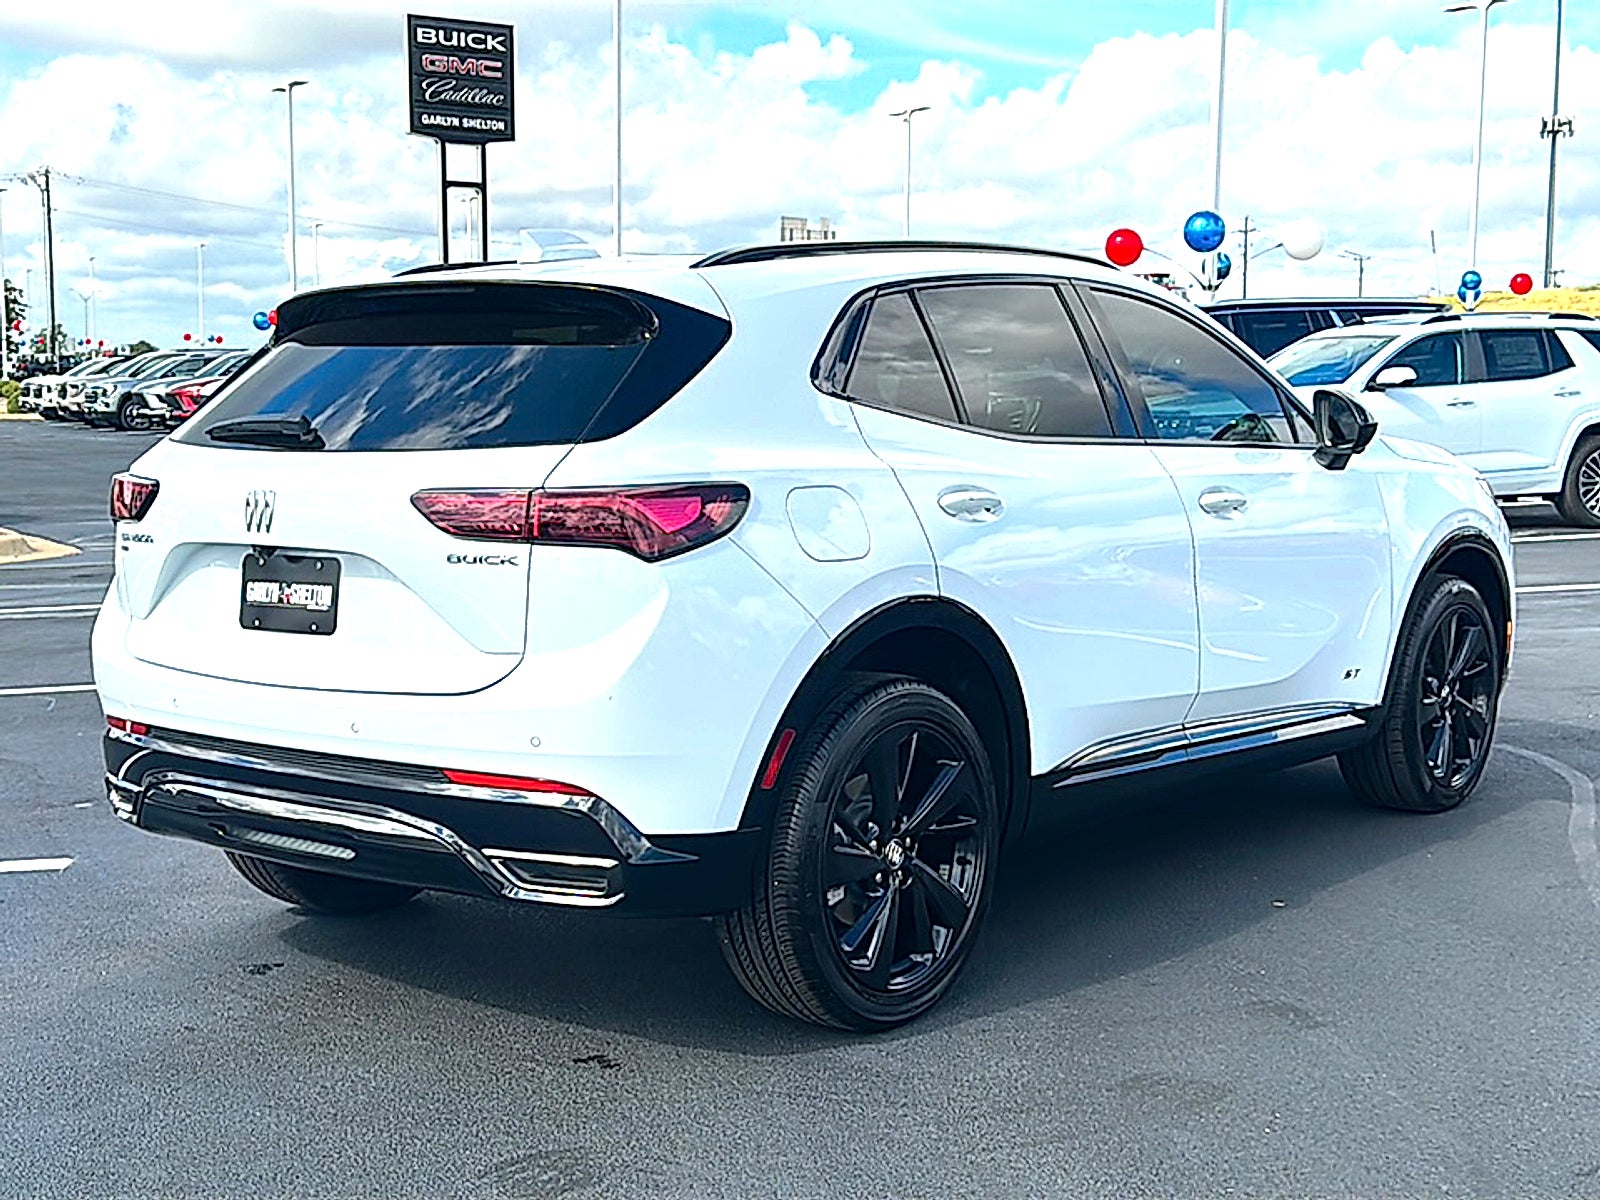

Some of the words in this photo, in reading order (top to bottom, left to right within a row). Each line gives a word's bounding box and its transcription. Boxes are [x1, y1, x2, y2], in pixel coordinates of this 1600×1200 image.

[416, 27, 507, 52] BUICK
[421, 53, 503, 78] GMC
[421, 77, 505, 106] Cadillac
[421, 113, 460, 127] GARLYN
[461, 117, 505, 131] SHELTON
[446, 553, 519, 566] BUICK
